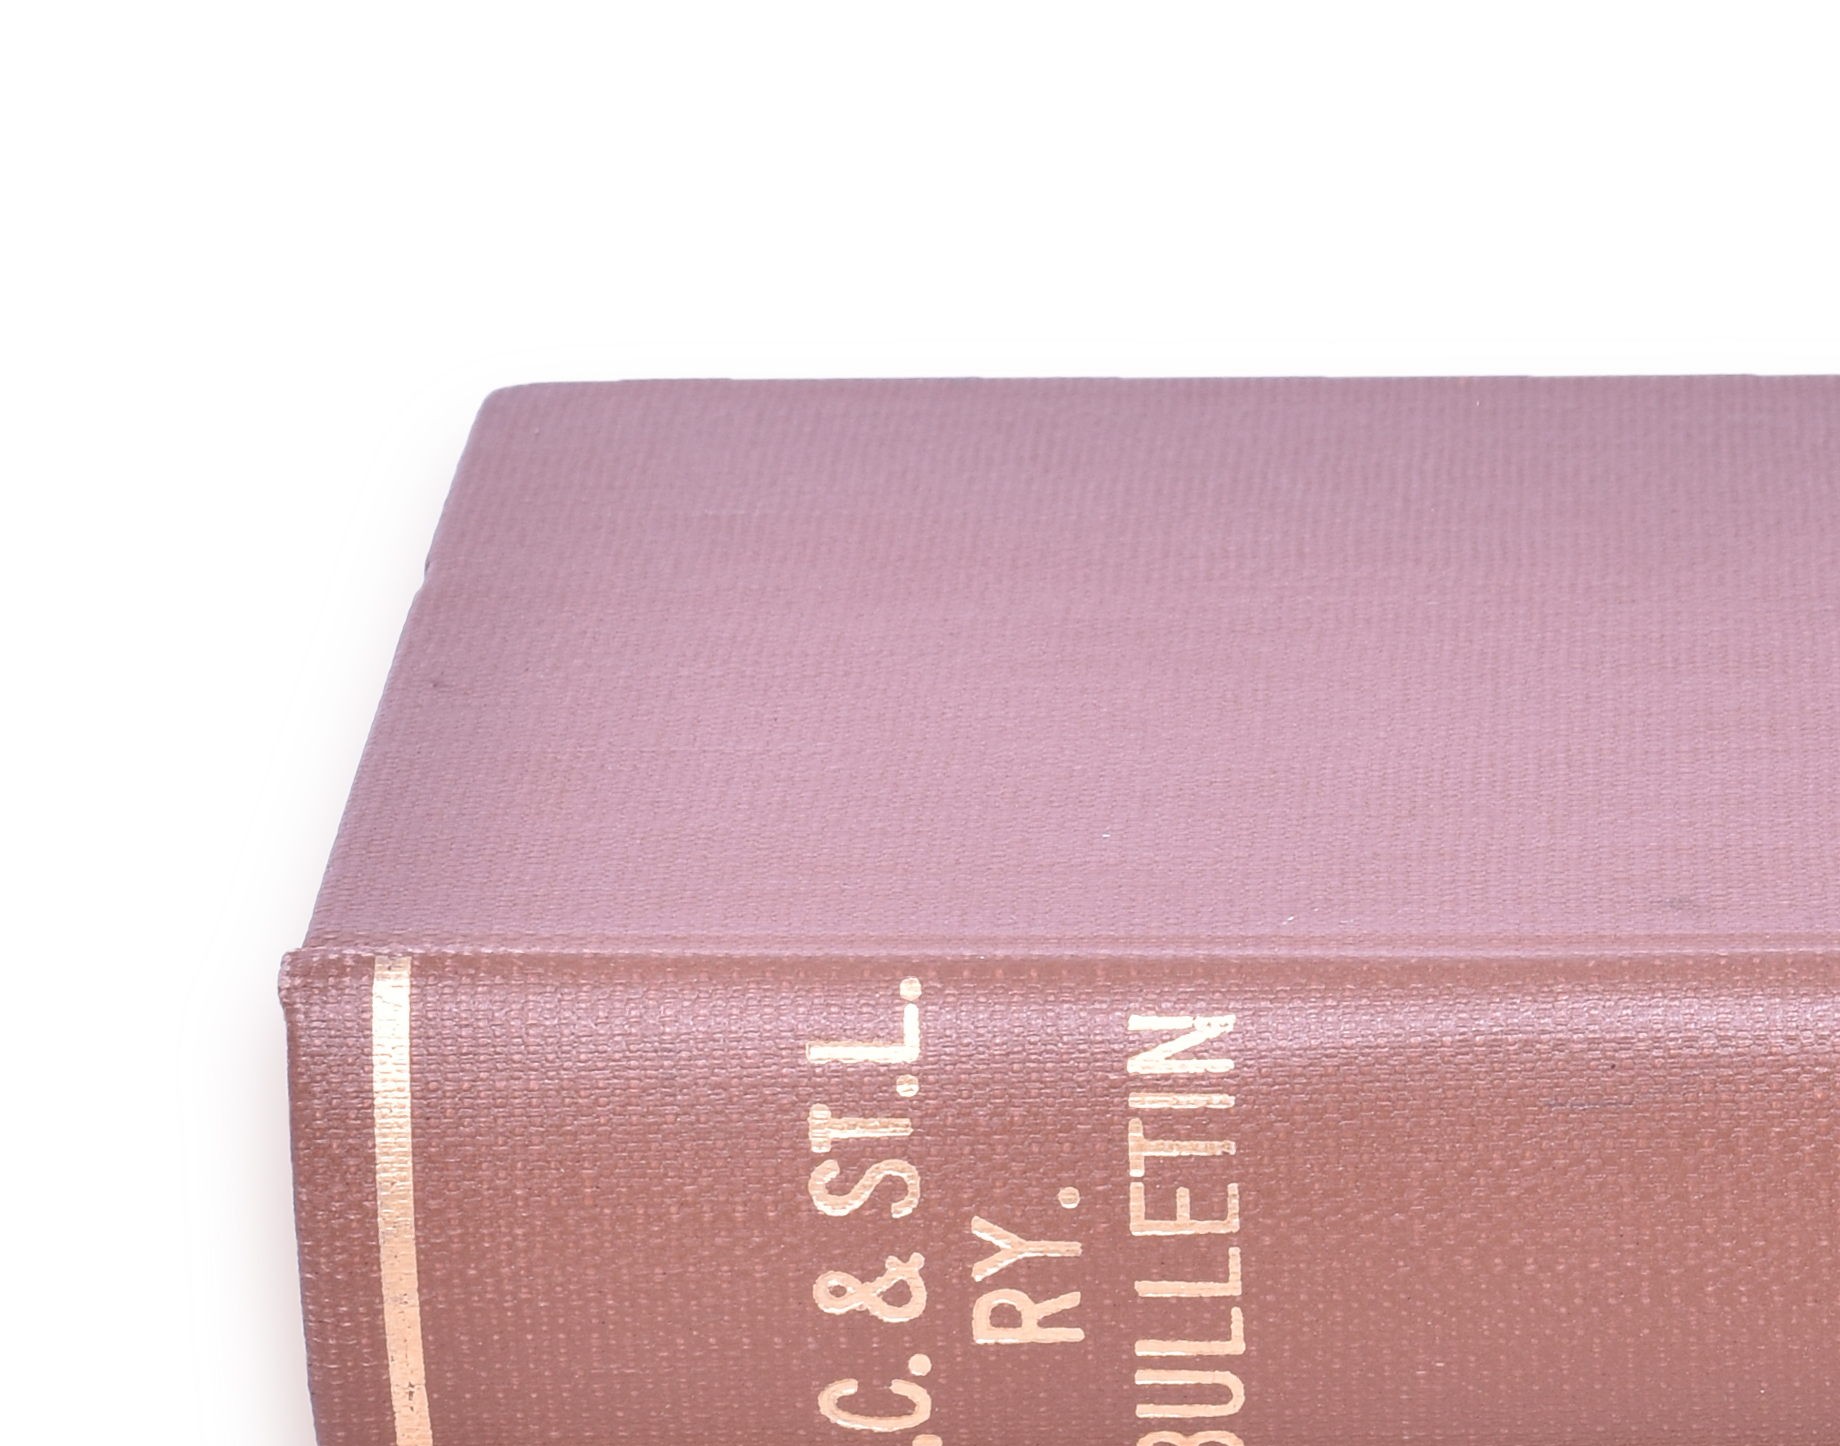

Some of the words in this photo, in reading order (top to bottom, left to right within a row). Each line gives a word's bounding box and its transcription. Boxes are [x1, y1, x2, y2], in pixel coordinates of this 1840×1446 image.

[806, 976, 923, 1218] ST.L.
[813, 1252, 927, 1323] &
[971, 1185, 1085, 1344] RY.
